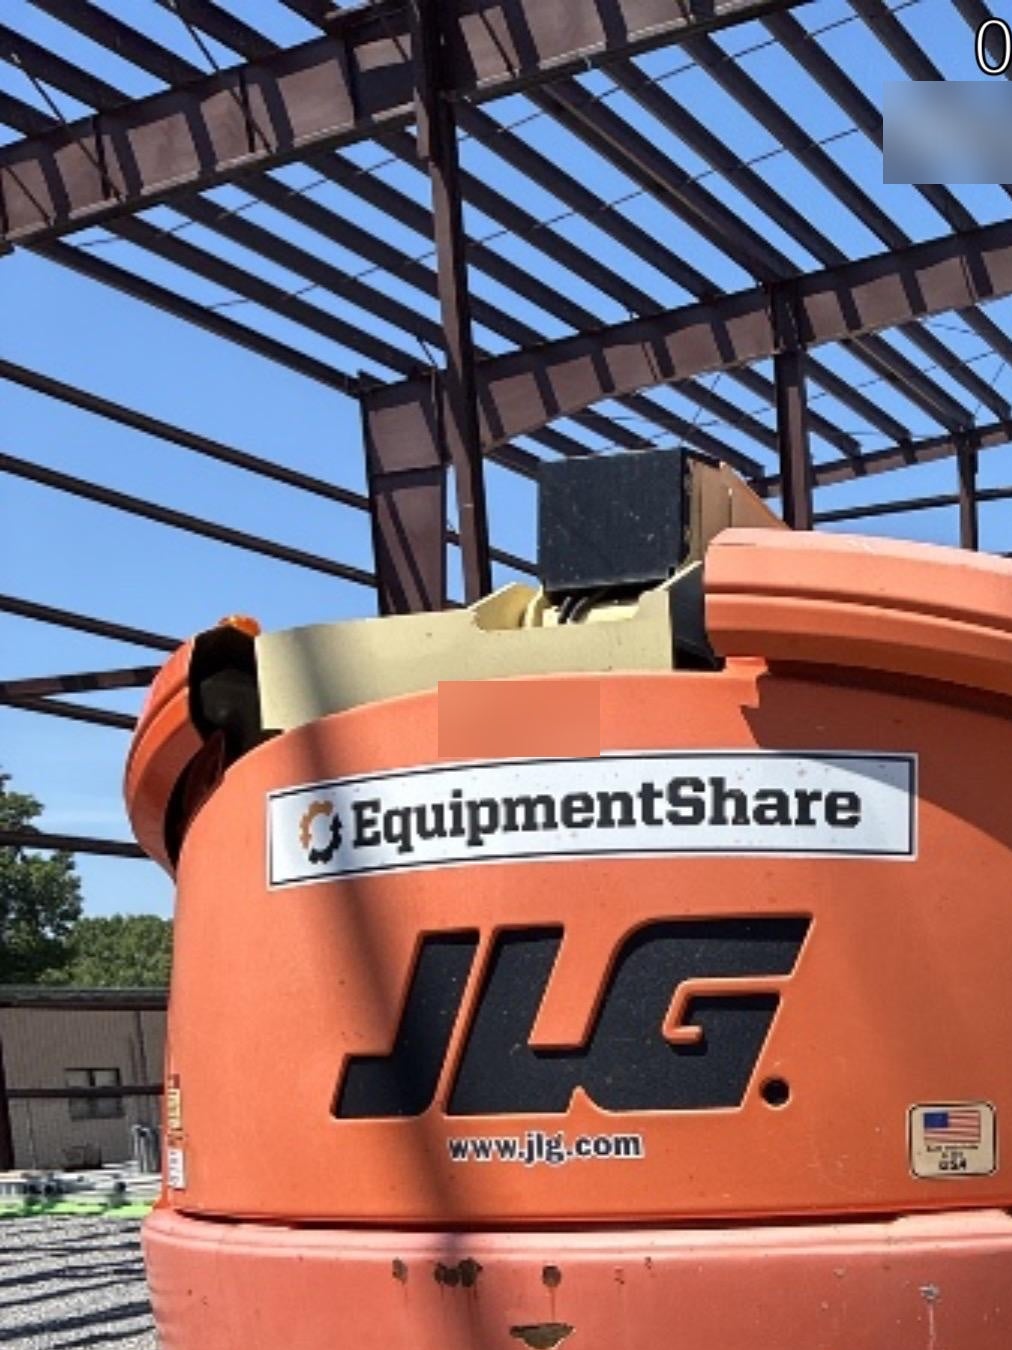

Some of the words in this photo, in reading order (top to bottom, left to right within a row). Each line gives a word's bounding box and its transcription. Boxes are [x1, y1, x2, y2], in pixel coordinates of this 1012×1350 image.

[351, 776, 862, 853] EquipmentShare
[330, 912, 814, 1119] JLG
[448, 1131, 643, 1166] www.jlg.com
